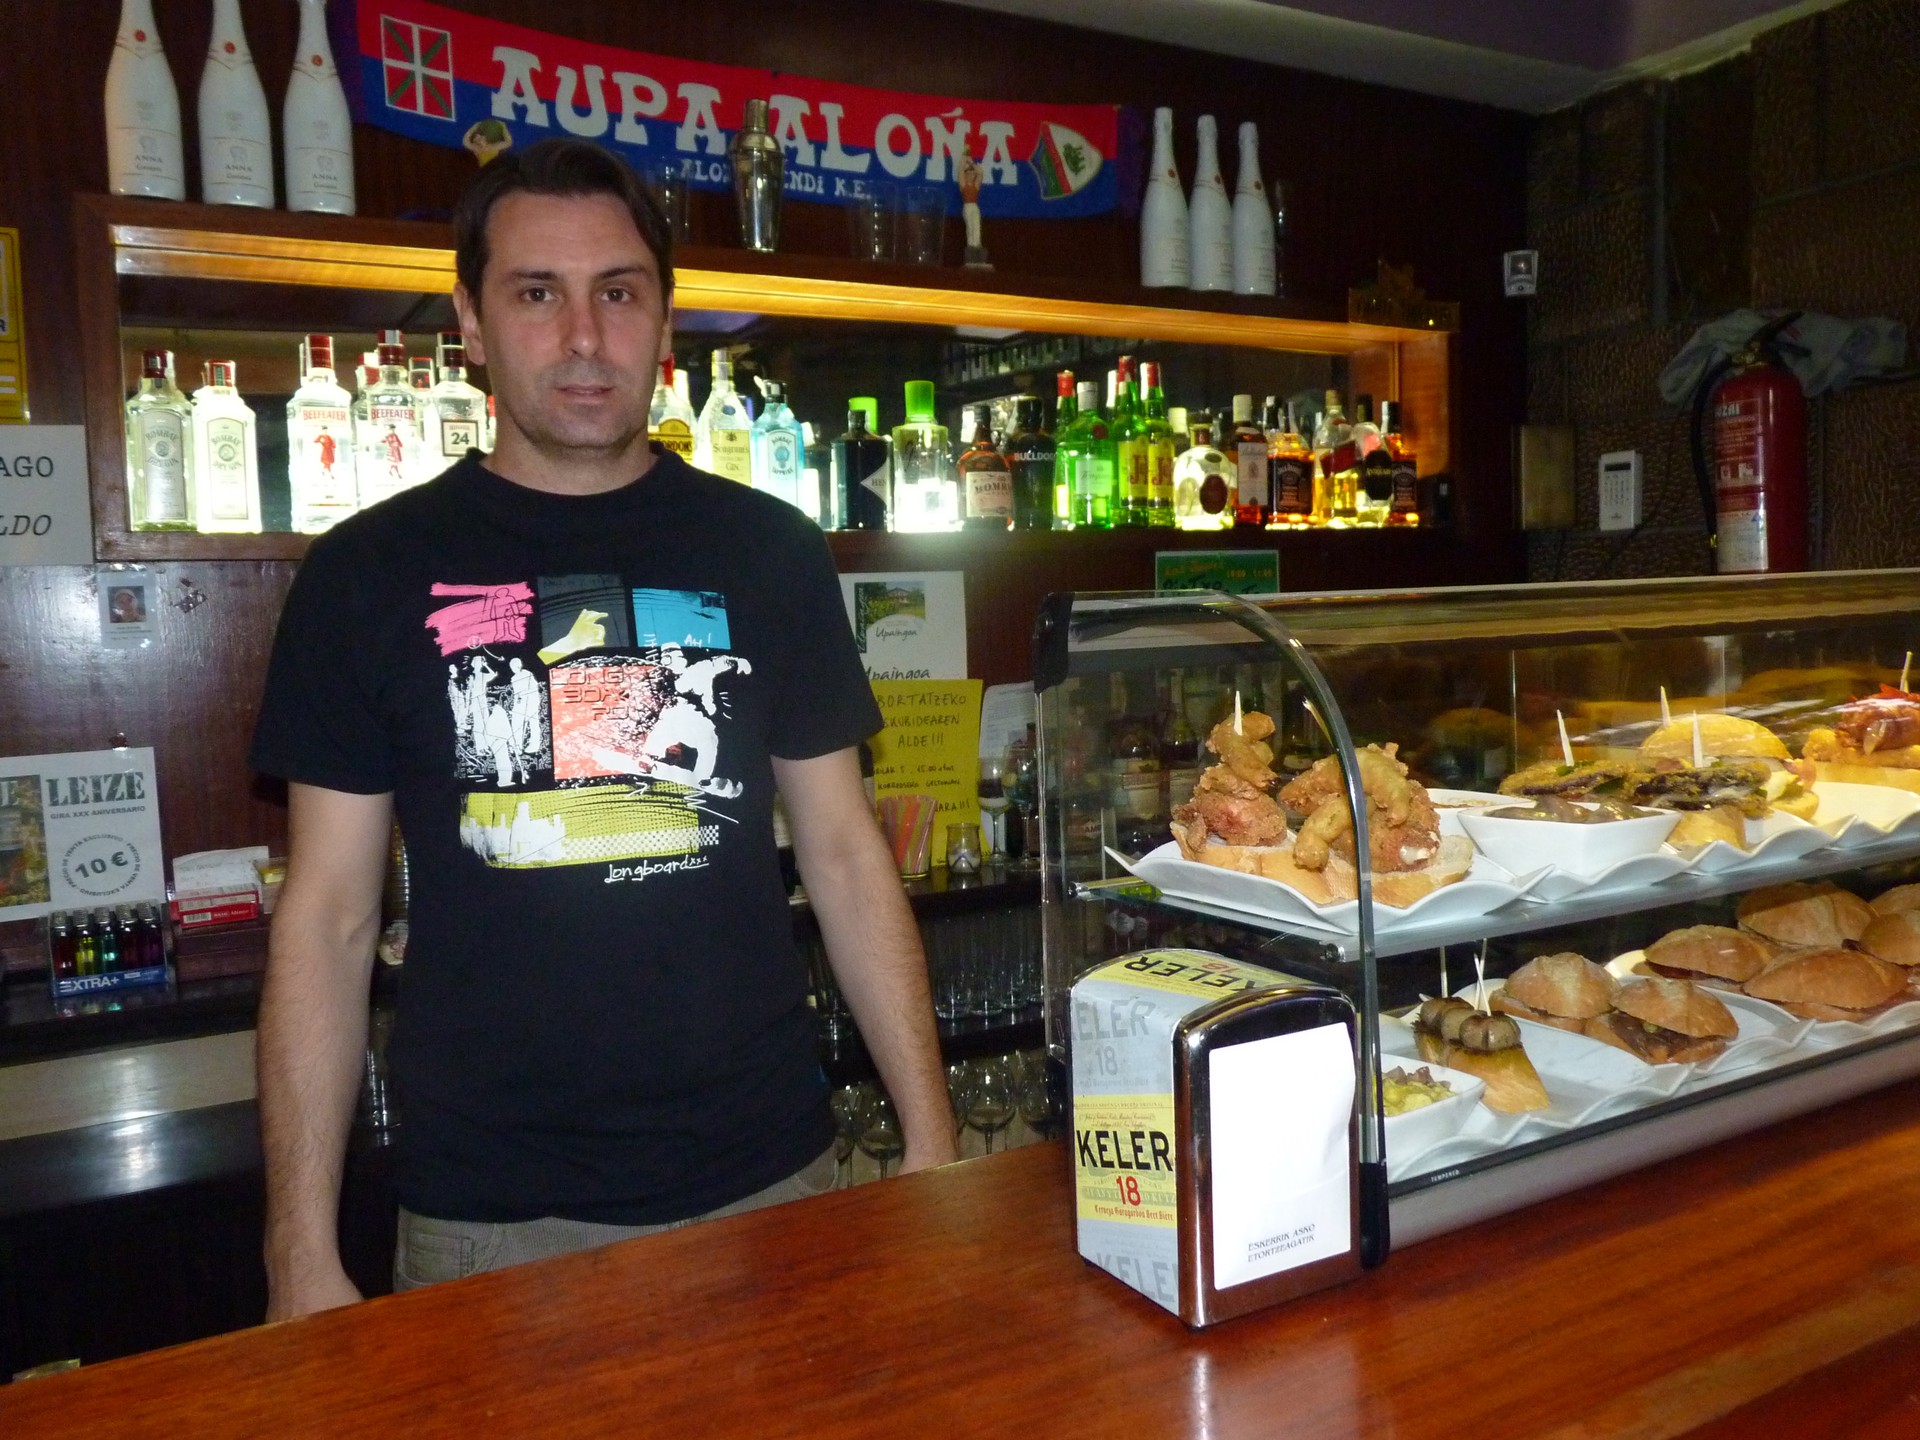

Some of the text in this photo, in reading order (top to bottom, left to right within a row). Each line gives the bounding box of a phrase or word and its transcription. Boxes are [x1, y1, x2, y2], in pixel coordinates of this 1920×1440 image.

[491, 46, 726, 155] AUPA
[303, 409, 346, 421] BEEFEATER
[371, 408, 415, 421] BEEFEATER
[145, 429, 178, 441] BOMBAY
[211, 434, 242, 446] BOMBAY
[451, 432, 469, 445] 24
[771, 436, 792, 445] BOMBAY
[713, 443, 750, 455] Seagram's
[876, 626, 917, 641] Upaingoa
[550, 666, 625, 685] LONG
[46, 772, 145, 807] LEIZE
[73, 810, 89, 818] XXX
[91, 805, 146, 816] ANIVERSARIO
[75, 851, 128, 878] 10 €
[1073, 1000, 1157, 1040] ELER
[1095, 1045, 1118, 1076] 18
[1076, 1130, 1174, 1172] KELER
[1116, 1175, 1142, 1207] 18
[1248, 1223, 1316, 1251] ESKERRIK ASKO
